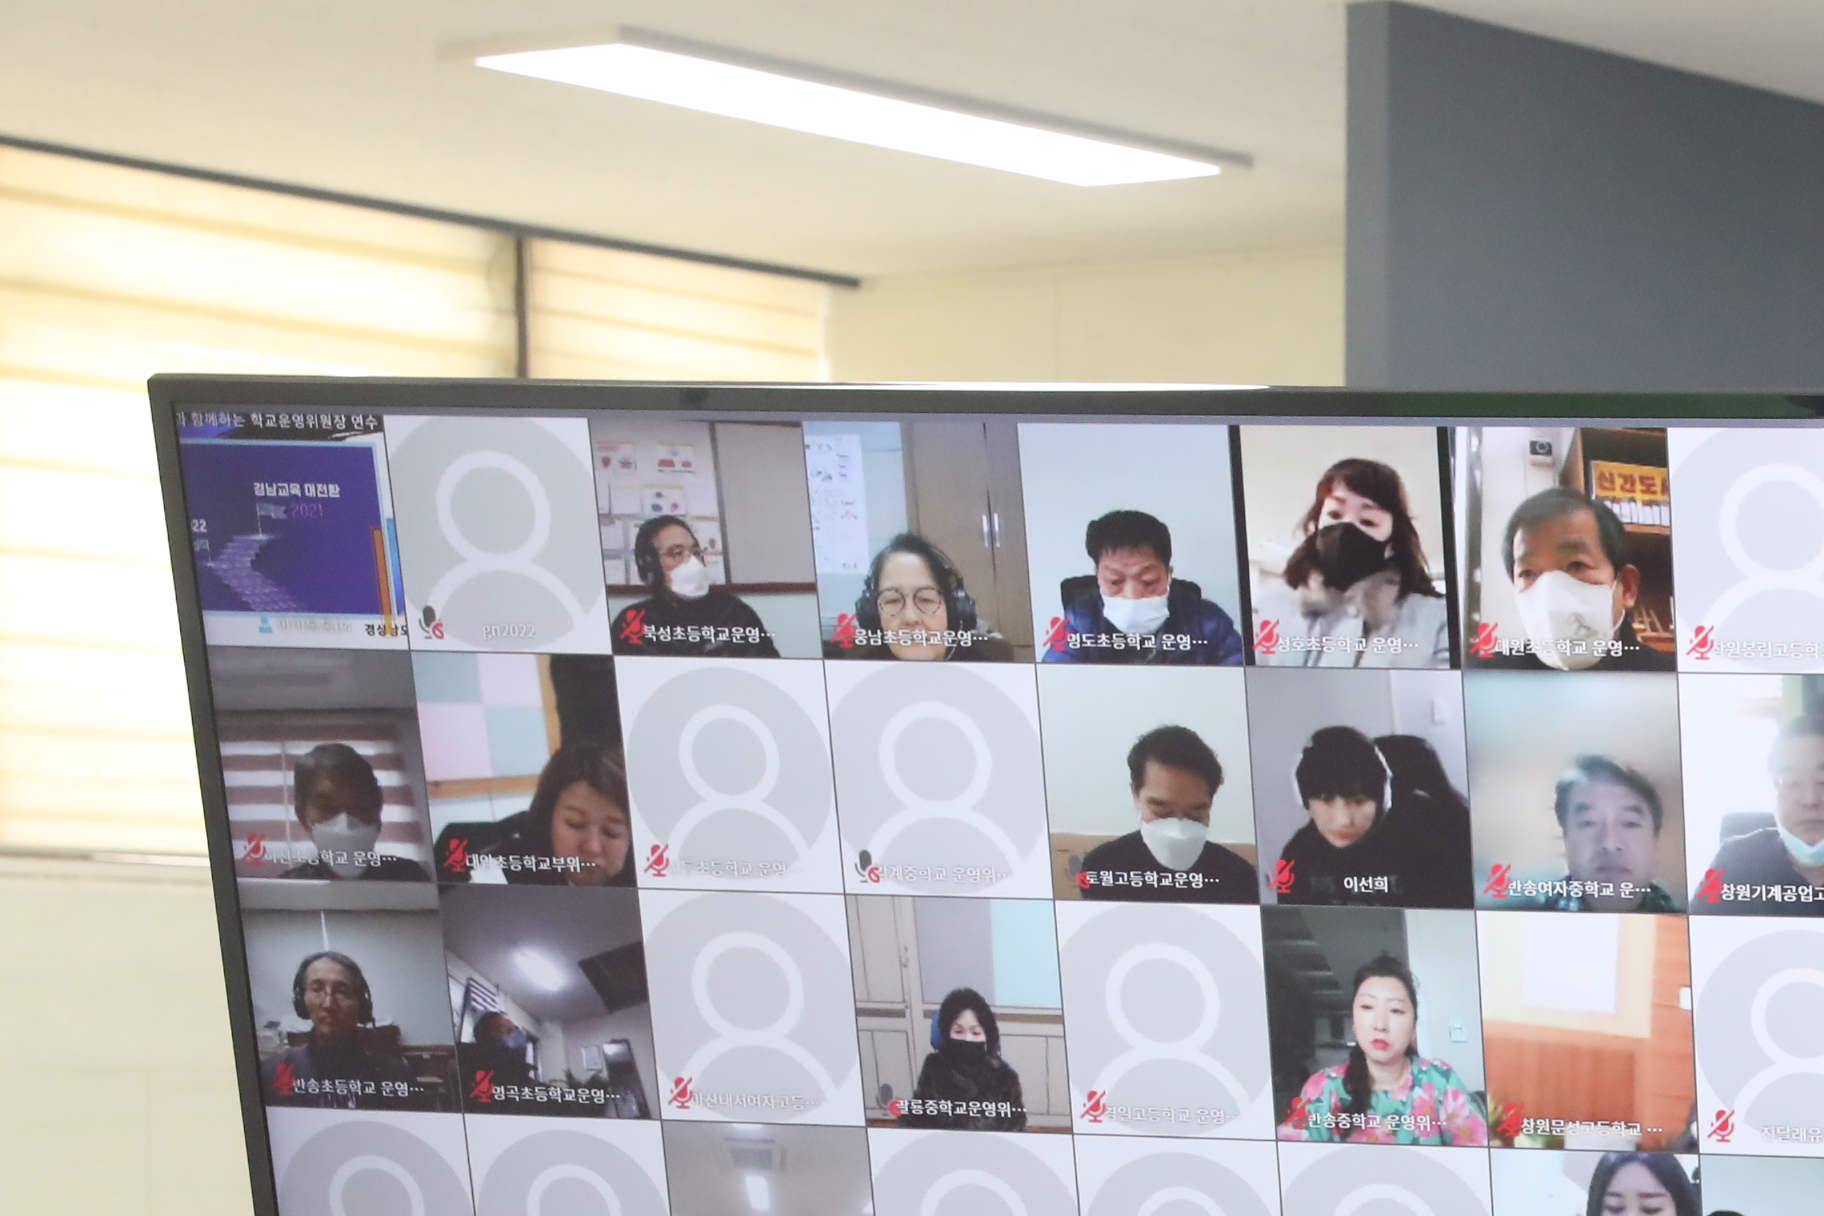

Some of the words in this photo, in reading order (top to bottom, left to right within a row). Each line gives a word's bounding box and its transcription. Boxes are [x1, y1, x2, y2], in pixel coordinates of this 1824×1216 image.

[191, 411, 245, 428] 함께하는
[250, 413, 346, 430] 학교운영위원장
[351, 415, 379, 430] 연수
[253, 482, 301, 497] 경남교육
[304, 483, 340, 498] 대전환
[291, 503, 323, 517] 2021
[482, 623, 536, 641] gn2022
[1066, 632, 1157, 652] 명도초등학교
[1342, 875, 1390, 893] 이선희
[1507, 880, 1615, 899] 반송여자중학교
[292, 1077, 377, 1097] 반송초등학교
[1307, 1112, 1382, 1129] 반송중학교
[1520, 1117, 1642, 1137] 창원문성고등학교
